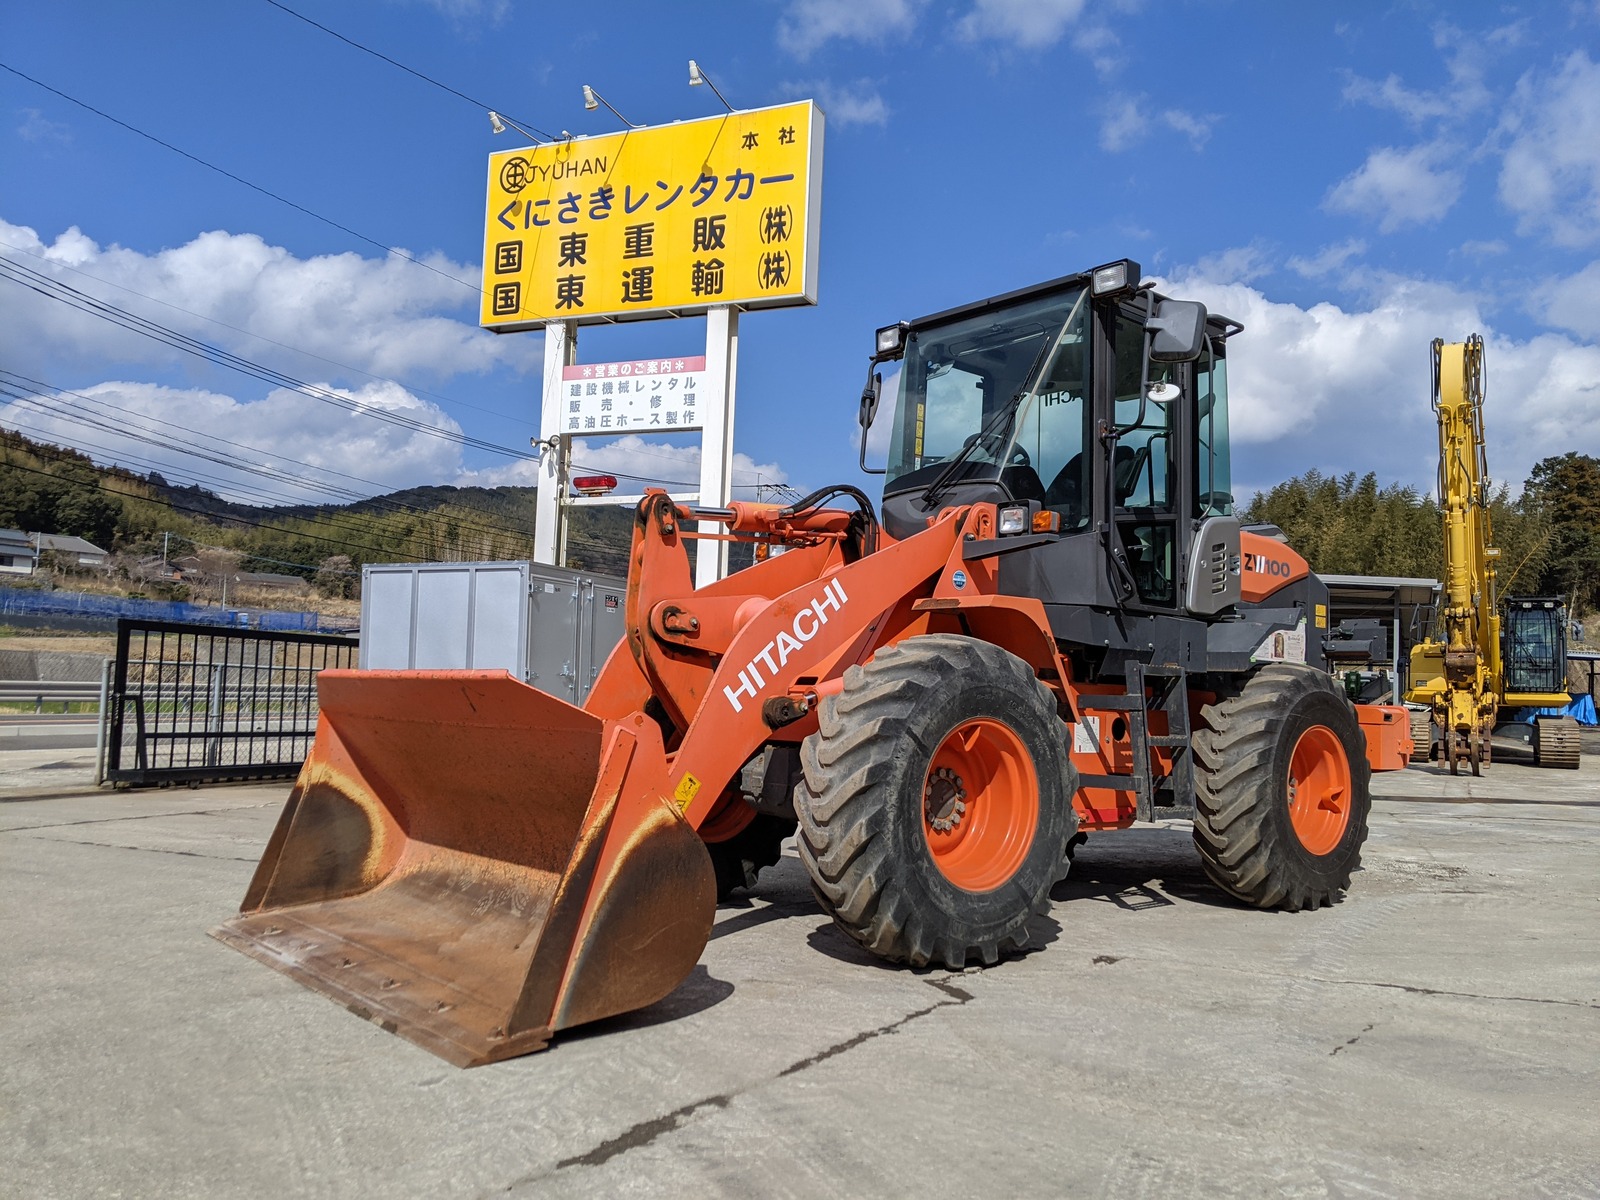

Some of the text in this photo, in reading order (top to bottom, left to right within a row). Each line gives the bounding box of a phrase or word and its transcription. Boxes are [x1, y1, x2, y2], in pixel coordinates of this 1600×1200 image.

[741, 125, 796, 151] 本社
[497, 168, 795, 231] くにさきレンタカー
[570, 377, 696, 397] 建設機械レンタル
[568, 410, 695, 430] 高油圧ホース製作
[723, 577, 849, 713] HITACHI
